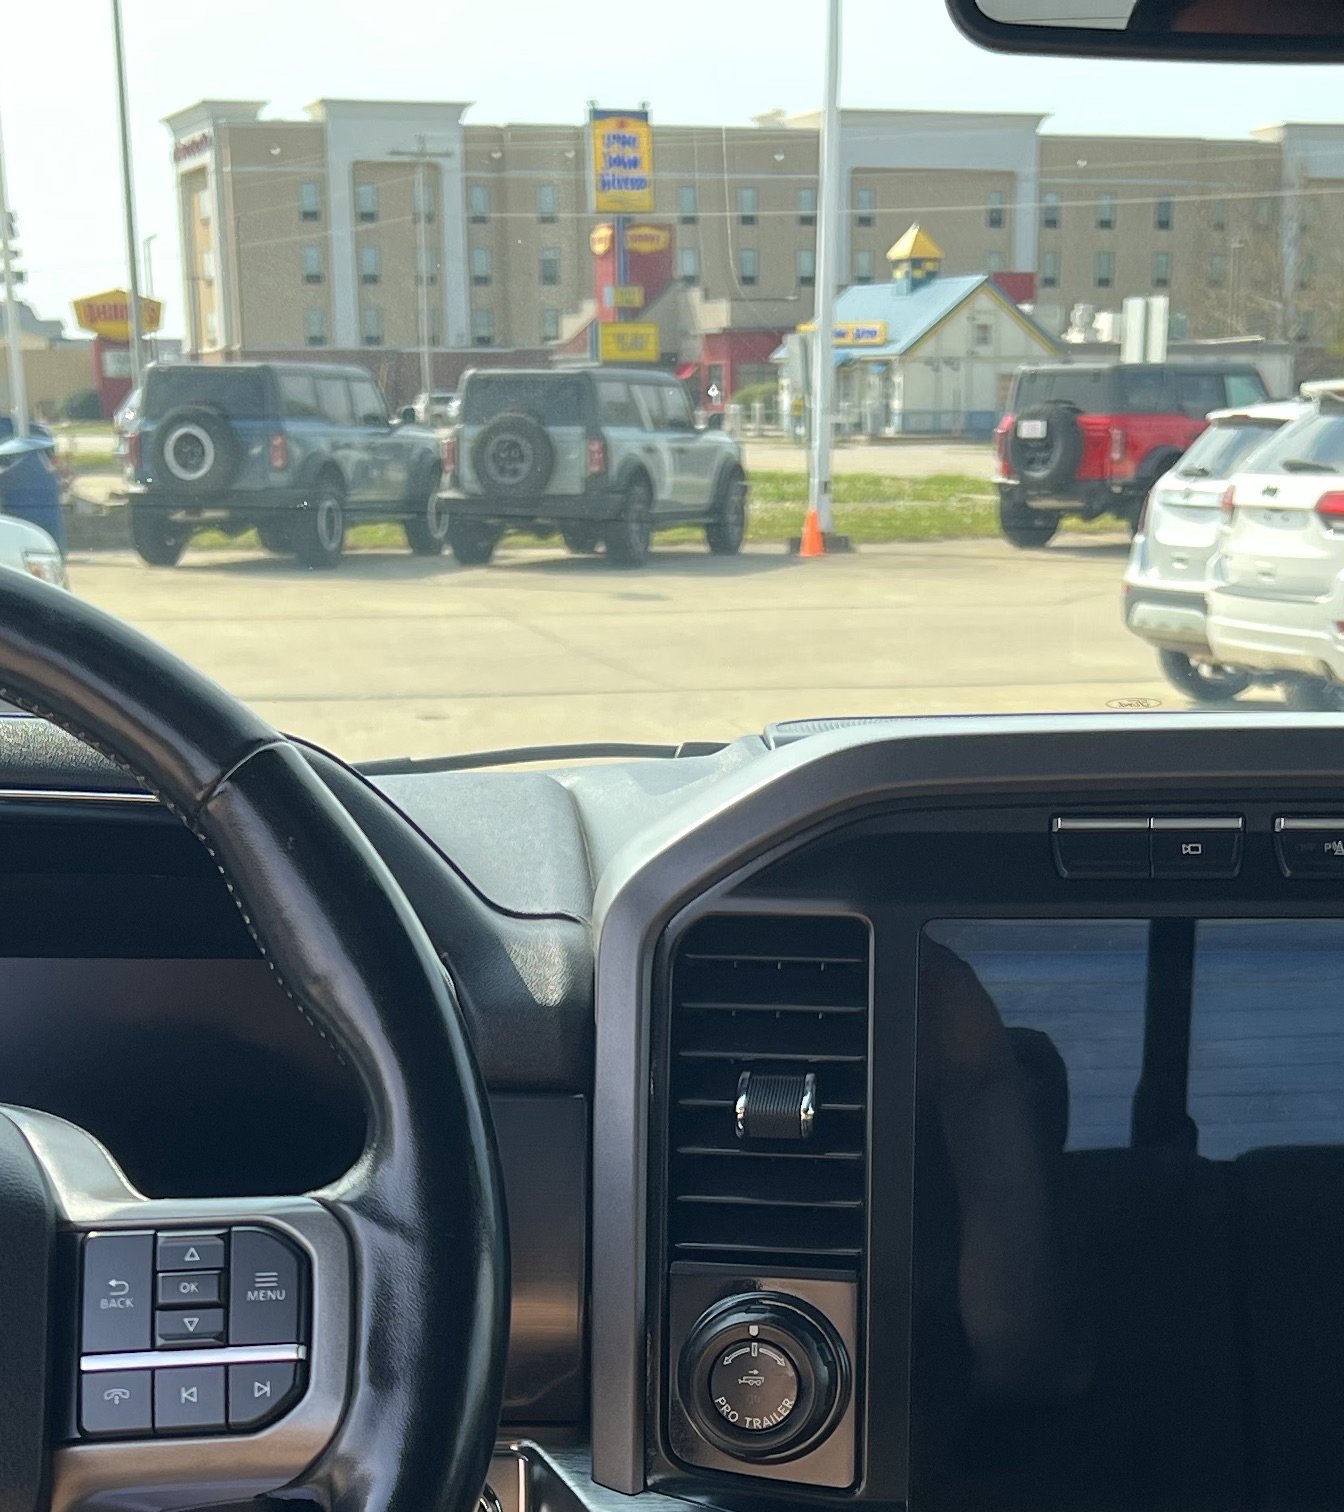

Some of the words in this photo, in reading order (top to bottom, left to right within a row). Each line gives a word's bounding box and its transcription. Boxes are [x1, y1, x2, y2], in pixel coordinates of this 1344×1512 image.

[179, 1282, 199, 1293] OK
[246, 1289, 286, 1302] MENU
[100, 1298, 134, 1309] BACK
[714, 1396, 739, 1423] PRO
[745, 1398, 796, 1429] TRAILER
